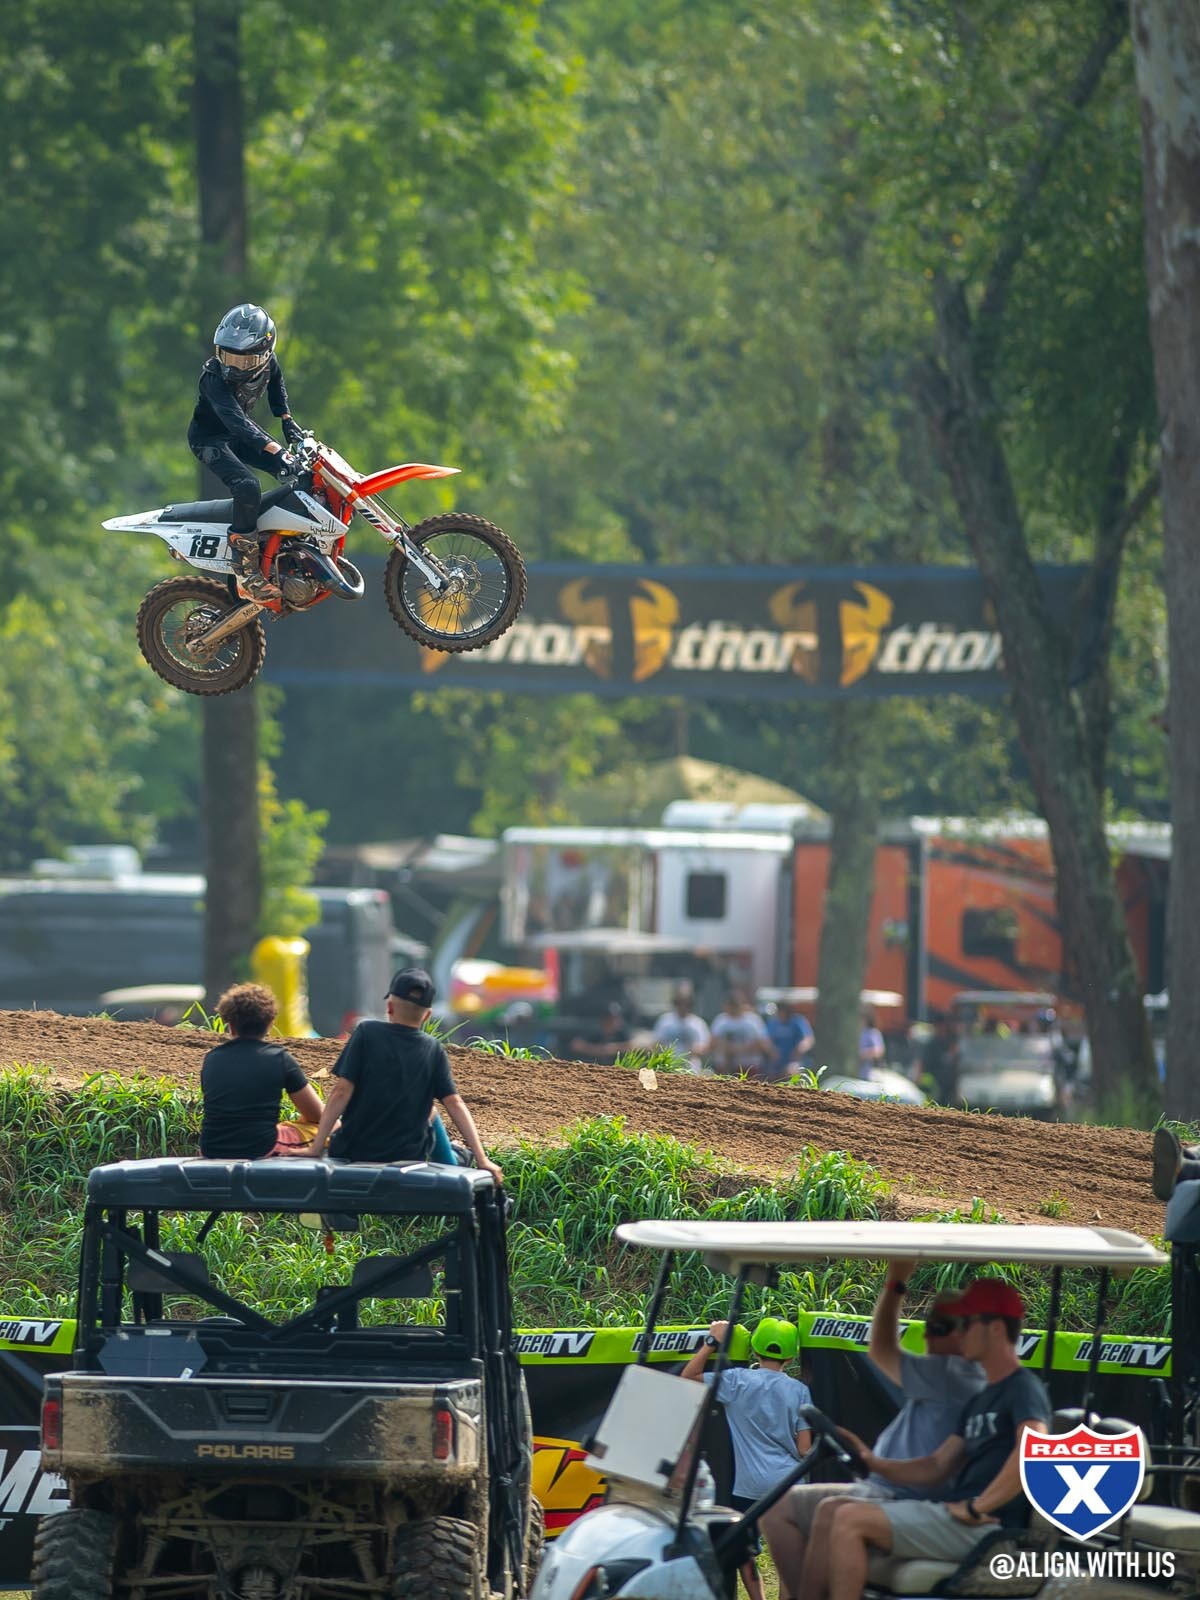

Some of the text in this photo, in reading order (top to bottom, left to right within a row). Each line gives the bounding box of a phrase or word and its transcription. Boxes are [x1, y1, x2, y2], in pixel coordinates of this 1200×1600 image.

[189, 535, 221, 558] 18
[460, 618, 613, 665] hor
[671, 620, 818, 672] thor
[197, 1445, 295, 1459] POLARIS
